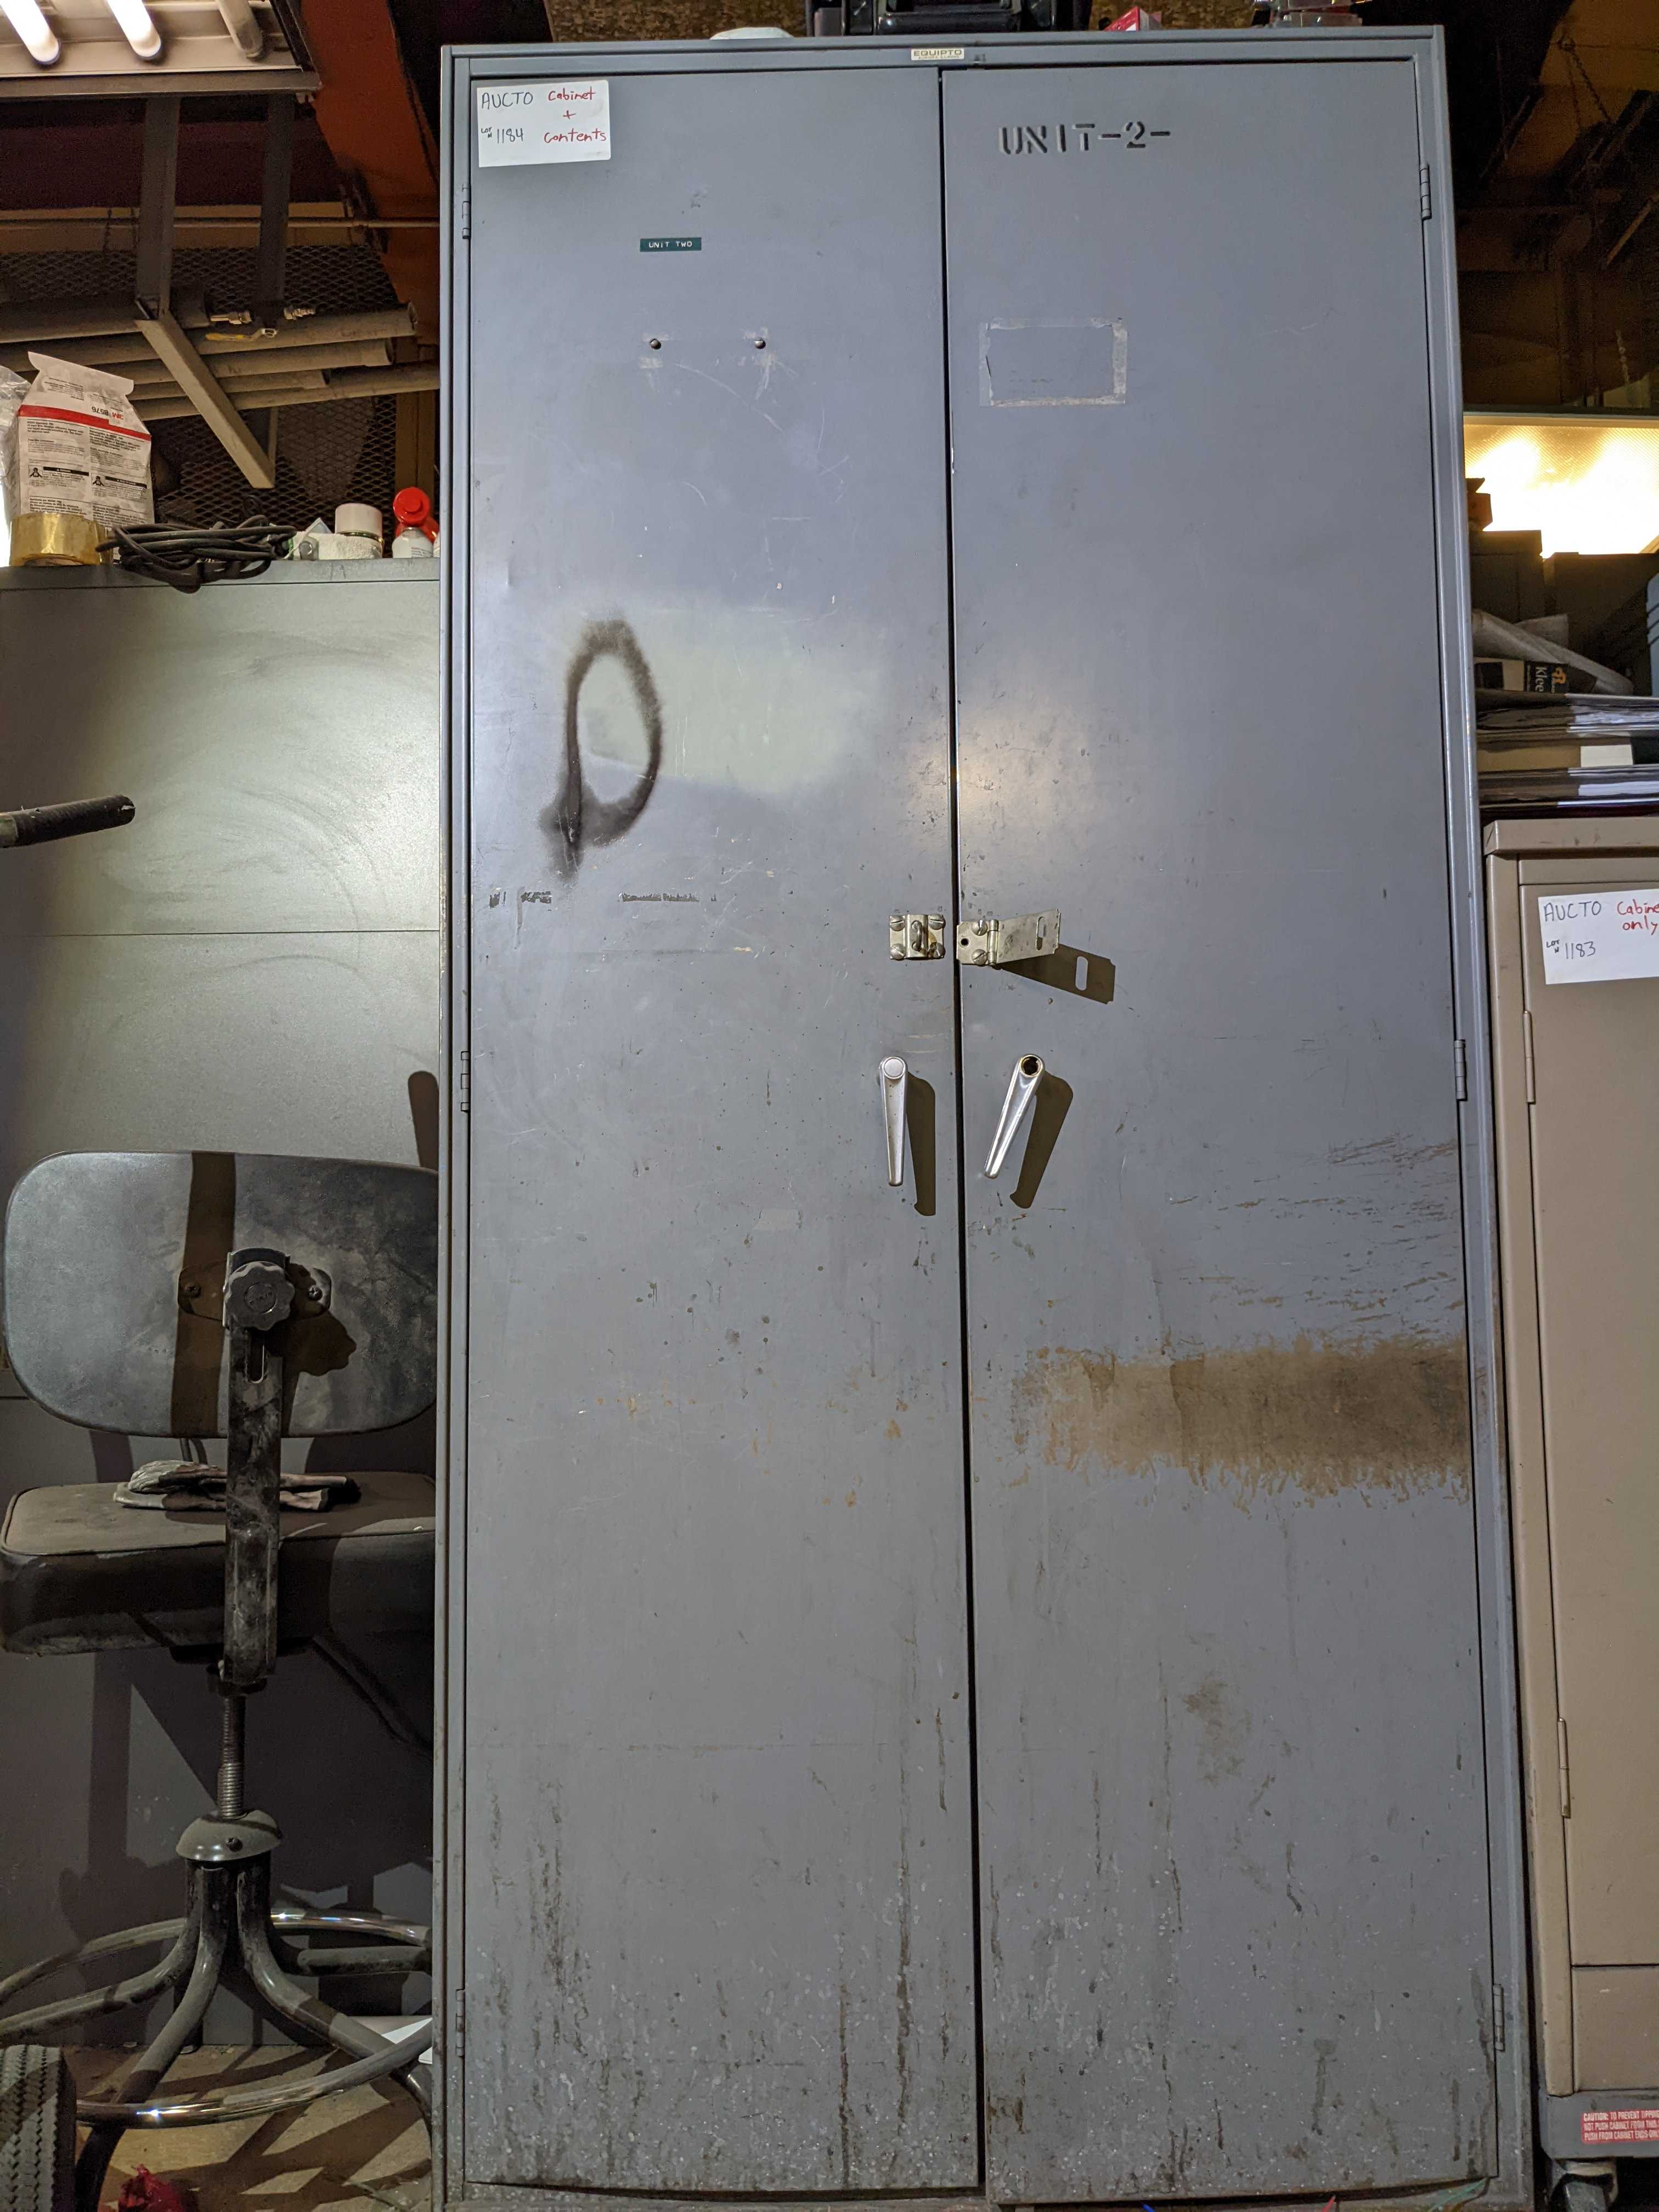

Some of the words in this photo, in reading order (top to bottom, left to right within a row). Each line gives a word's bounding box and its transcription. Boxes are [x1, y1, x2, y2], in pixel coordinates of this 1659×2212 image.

[481, 92, 533, 110] AUCTO
[496, 127, 524, 144] 1184
[91, 406, 109, 416] 8576
[111, 412, 125, 420] 3M
[1543, 901, 1602, 922] AUCTO
[1622, 915, 1658, 935] only
[1565, 941, 1596, 960] 1183
[1583, 2112, 1609, 2121] CAUTION:
[1610, 2112, 1617, 2120] TO
[1617, 2111, 1640, 2120] PREVENT
[1609, 2120, 1629, 2130] CABINET
[1613, 2130, 1634, 2140] CABINET
